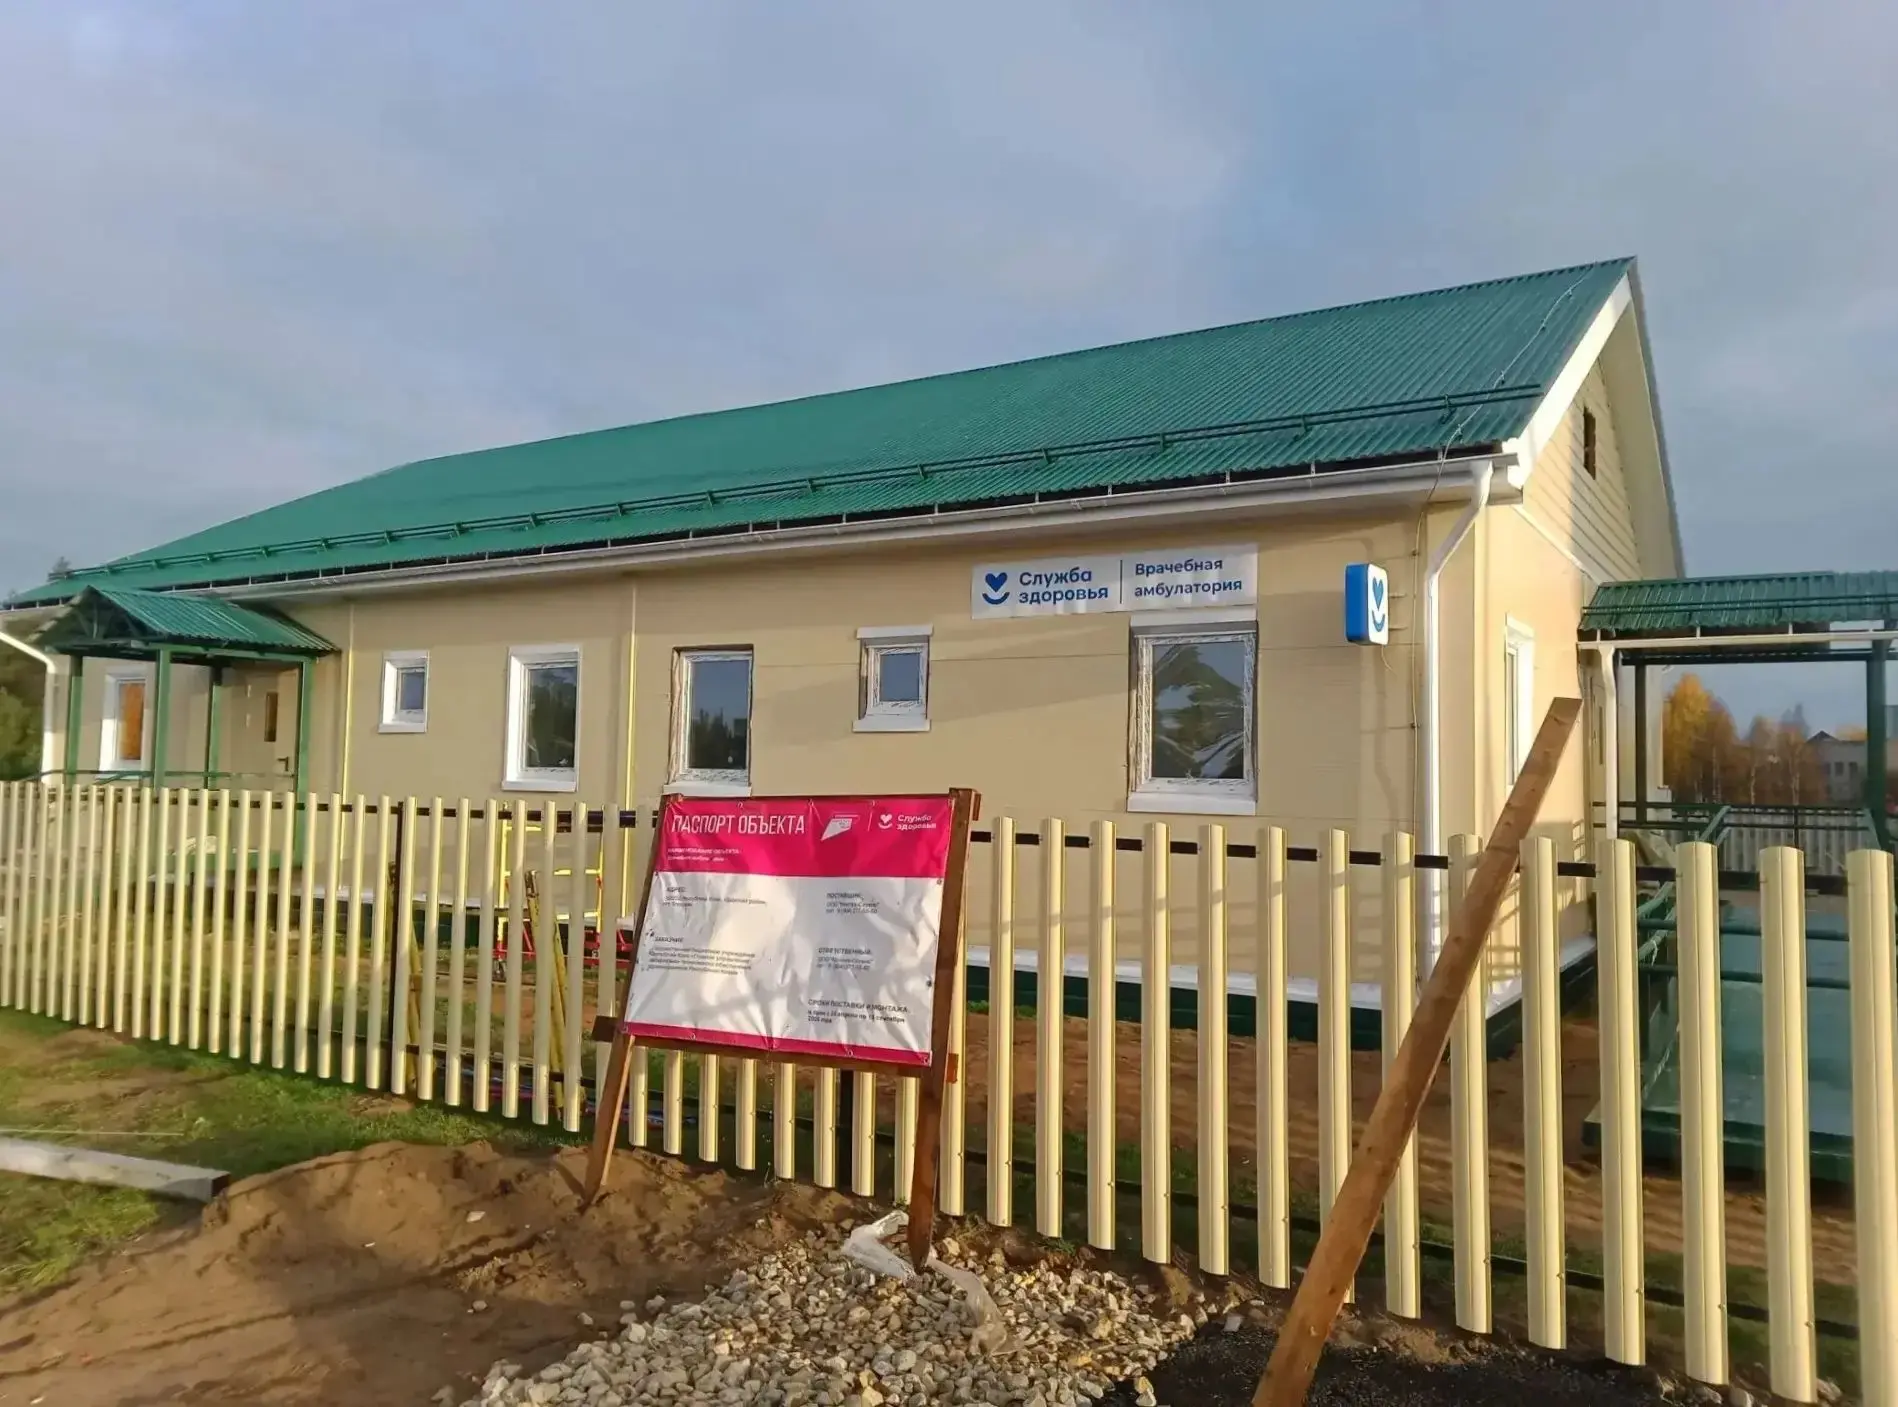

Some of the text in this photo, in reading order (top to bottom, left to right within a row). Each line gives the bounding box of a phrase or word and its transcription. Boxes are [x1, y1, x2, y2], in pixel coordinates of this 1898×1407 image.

[1019, 567, 1092, 588] Служба
[1135, 558, 1223, 578] Врачебная
[1018, 585, 1109, 605] здоровья
[1134, 579, 1242, 599] амбулатория
[671, 814, 805, 834] ПАСПОРТ ОБЪЕКТА
[897, 814, 932, 824] Служба
